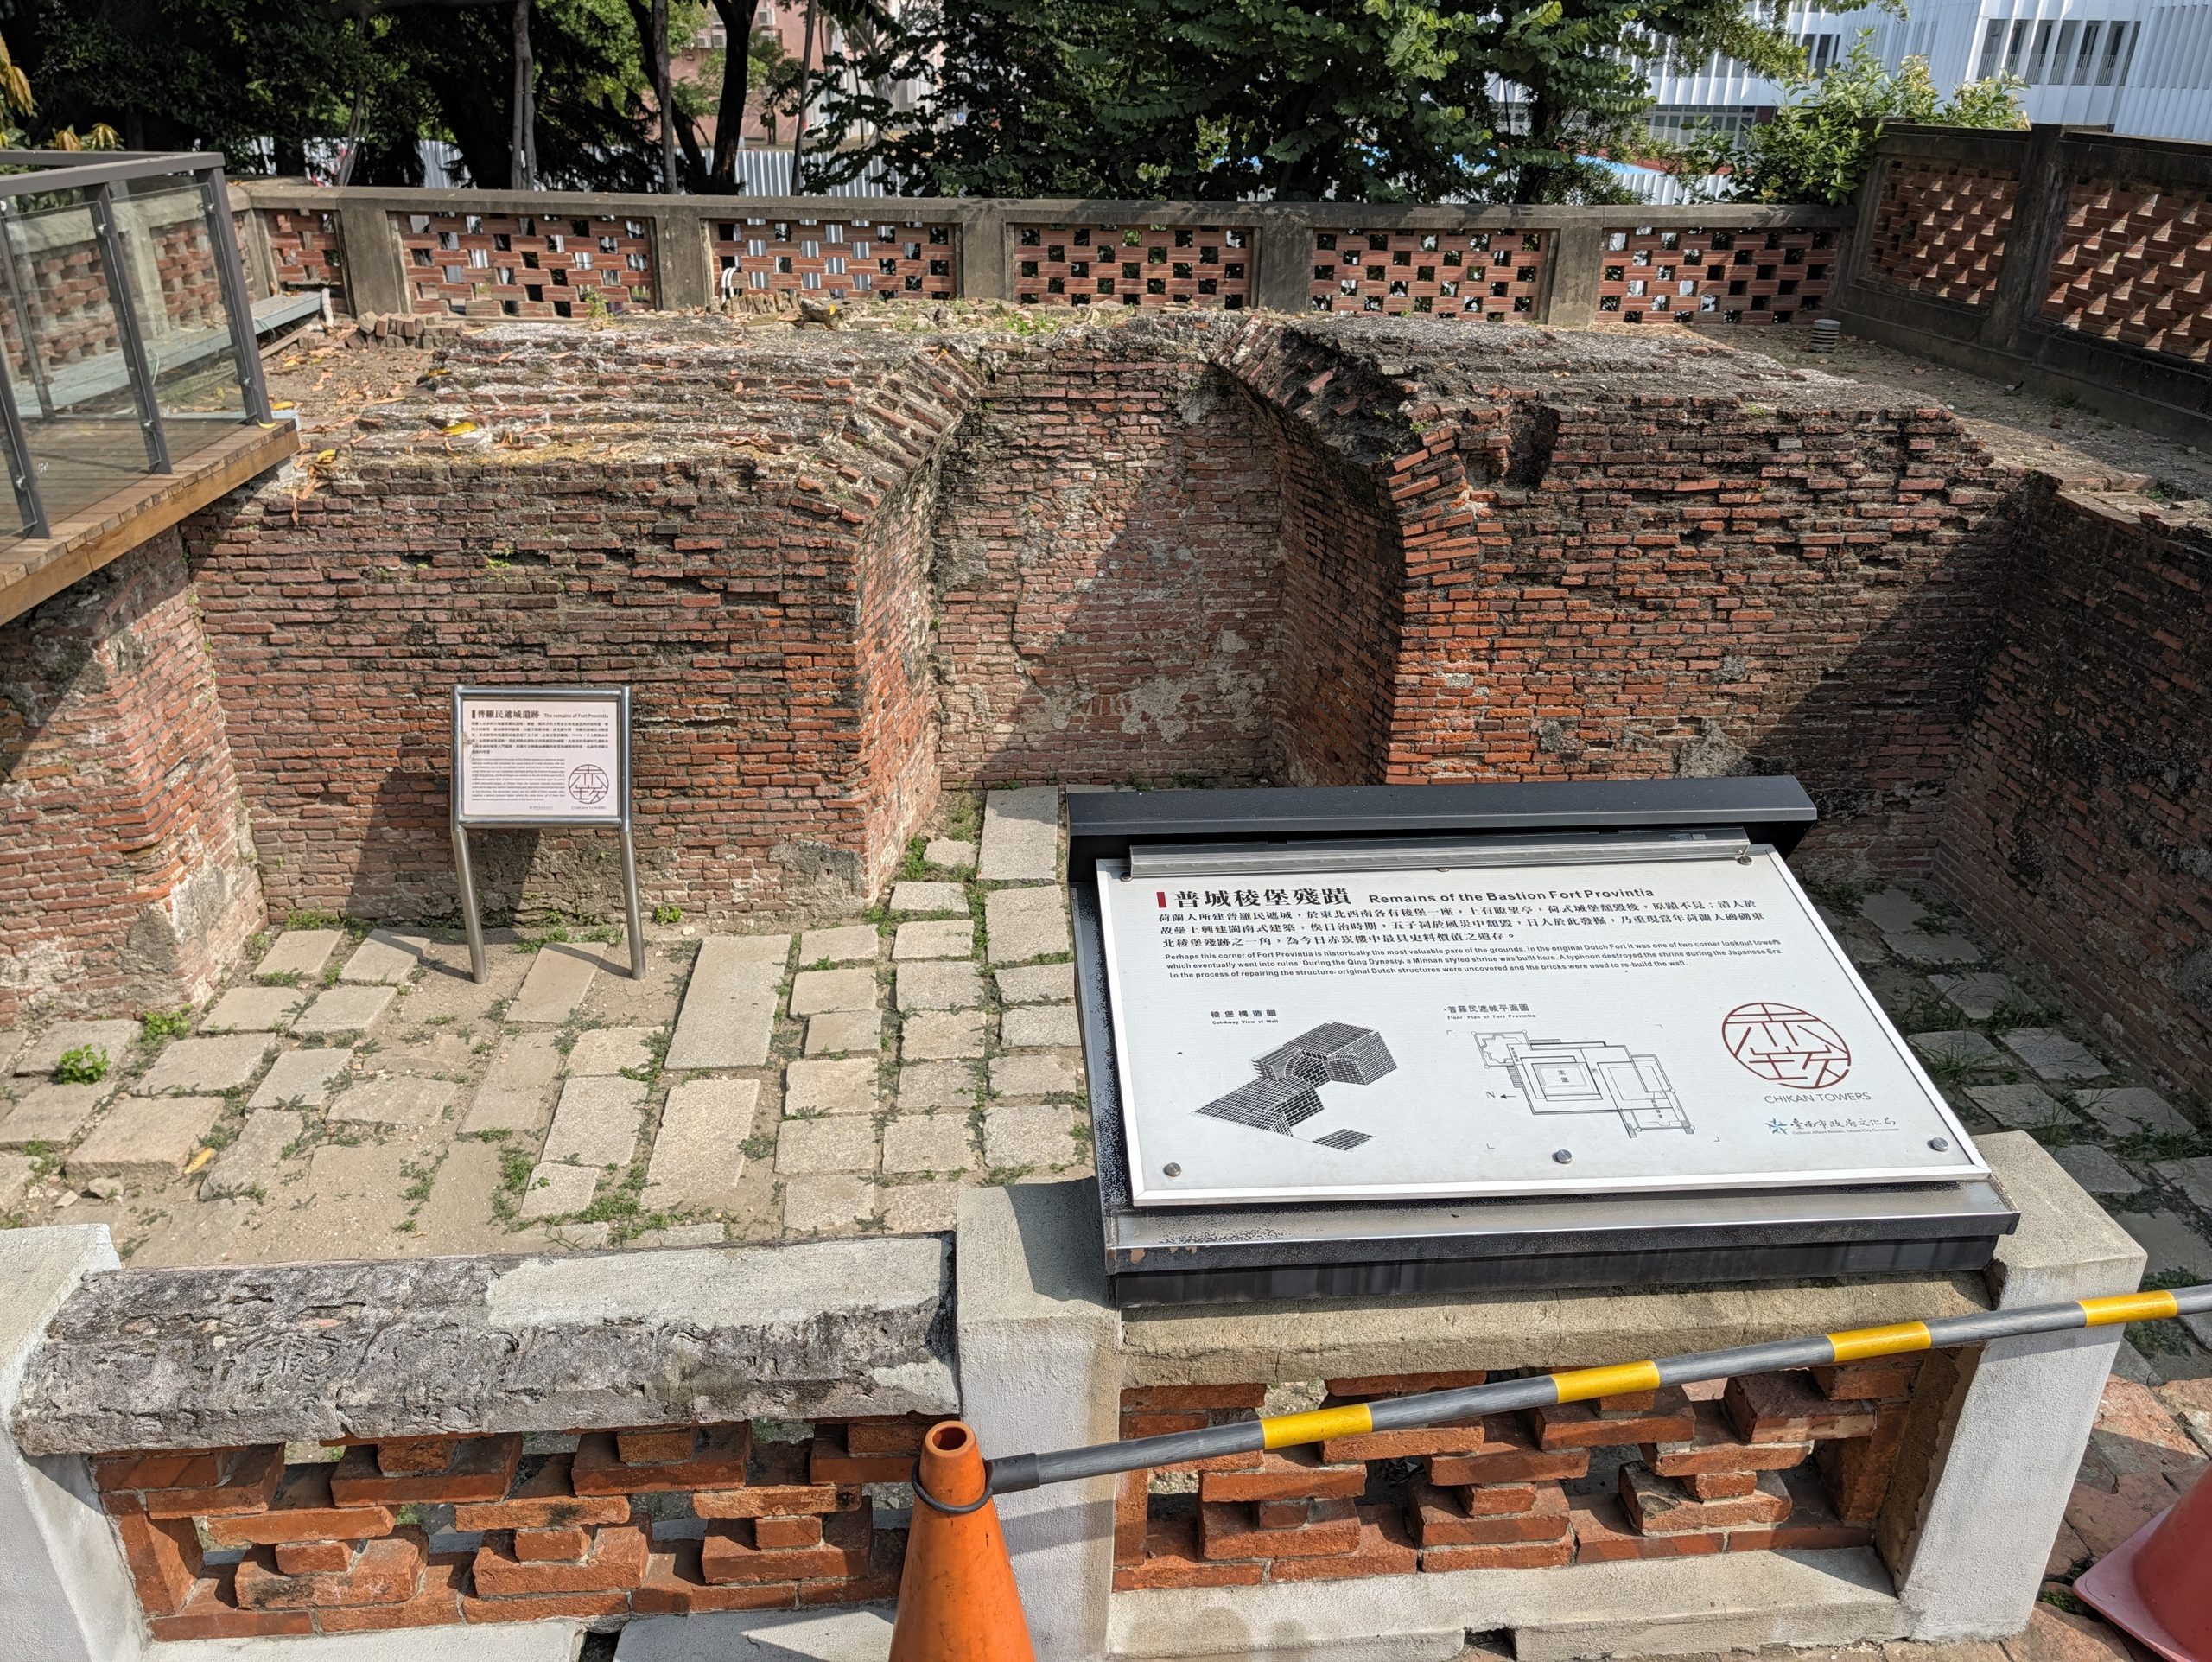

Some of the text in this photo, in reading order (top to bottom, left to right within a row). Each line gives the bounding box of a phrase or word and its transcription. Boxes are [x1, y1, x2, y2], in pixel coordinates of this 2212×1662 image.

[1368, 888, 1655, 903] Remains of the Bastion Fort Provintia
[1164, 952, 1199, 961] Perhaps
[1274, 949, 1313, 958] Provintia
[1323, 948, 1370, 958] historically
[1551, 943, 1583, 952] original
[1192, 961, 1236, 971] eventually
[1302, 958, 1332, 967] During
[1345, 958, 1368, 966] Qing
[1444, 955, 1471, 964] styled
[1566, 952, 1601, 961] typhoon
[1601, 951, 1643, 960] destroyed
[1685, 949, 1713, 958] during
[1727, 947, 1766, 957] Japanese
[1195, 971, 1230, 980] process
[1240, 969, 1281, 978] repairing
[1337, 967, 1370, 976] original
[1484, 1090, 1497, 1099] N
[1764, 1092, 1872, 1105] CHIKAN TOWERS
